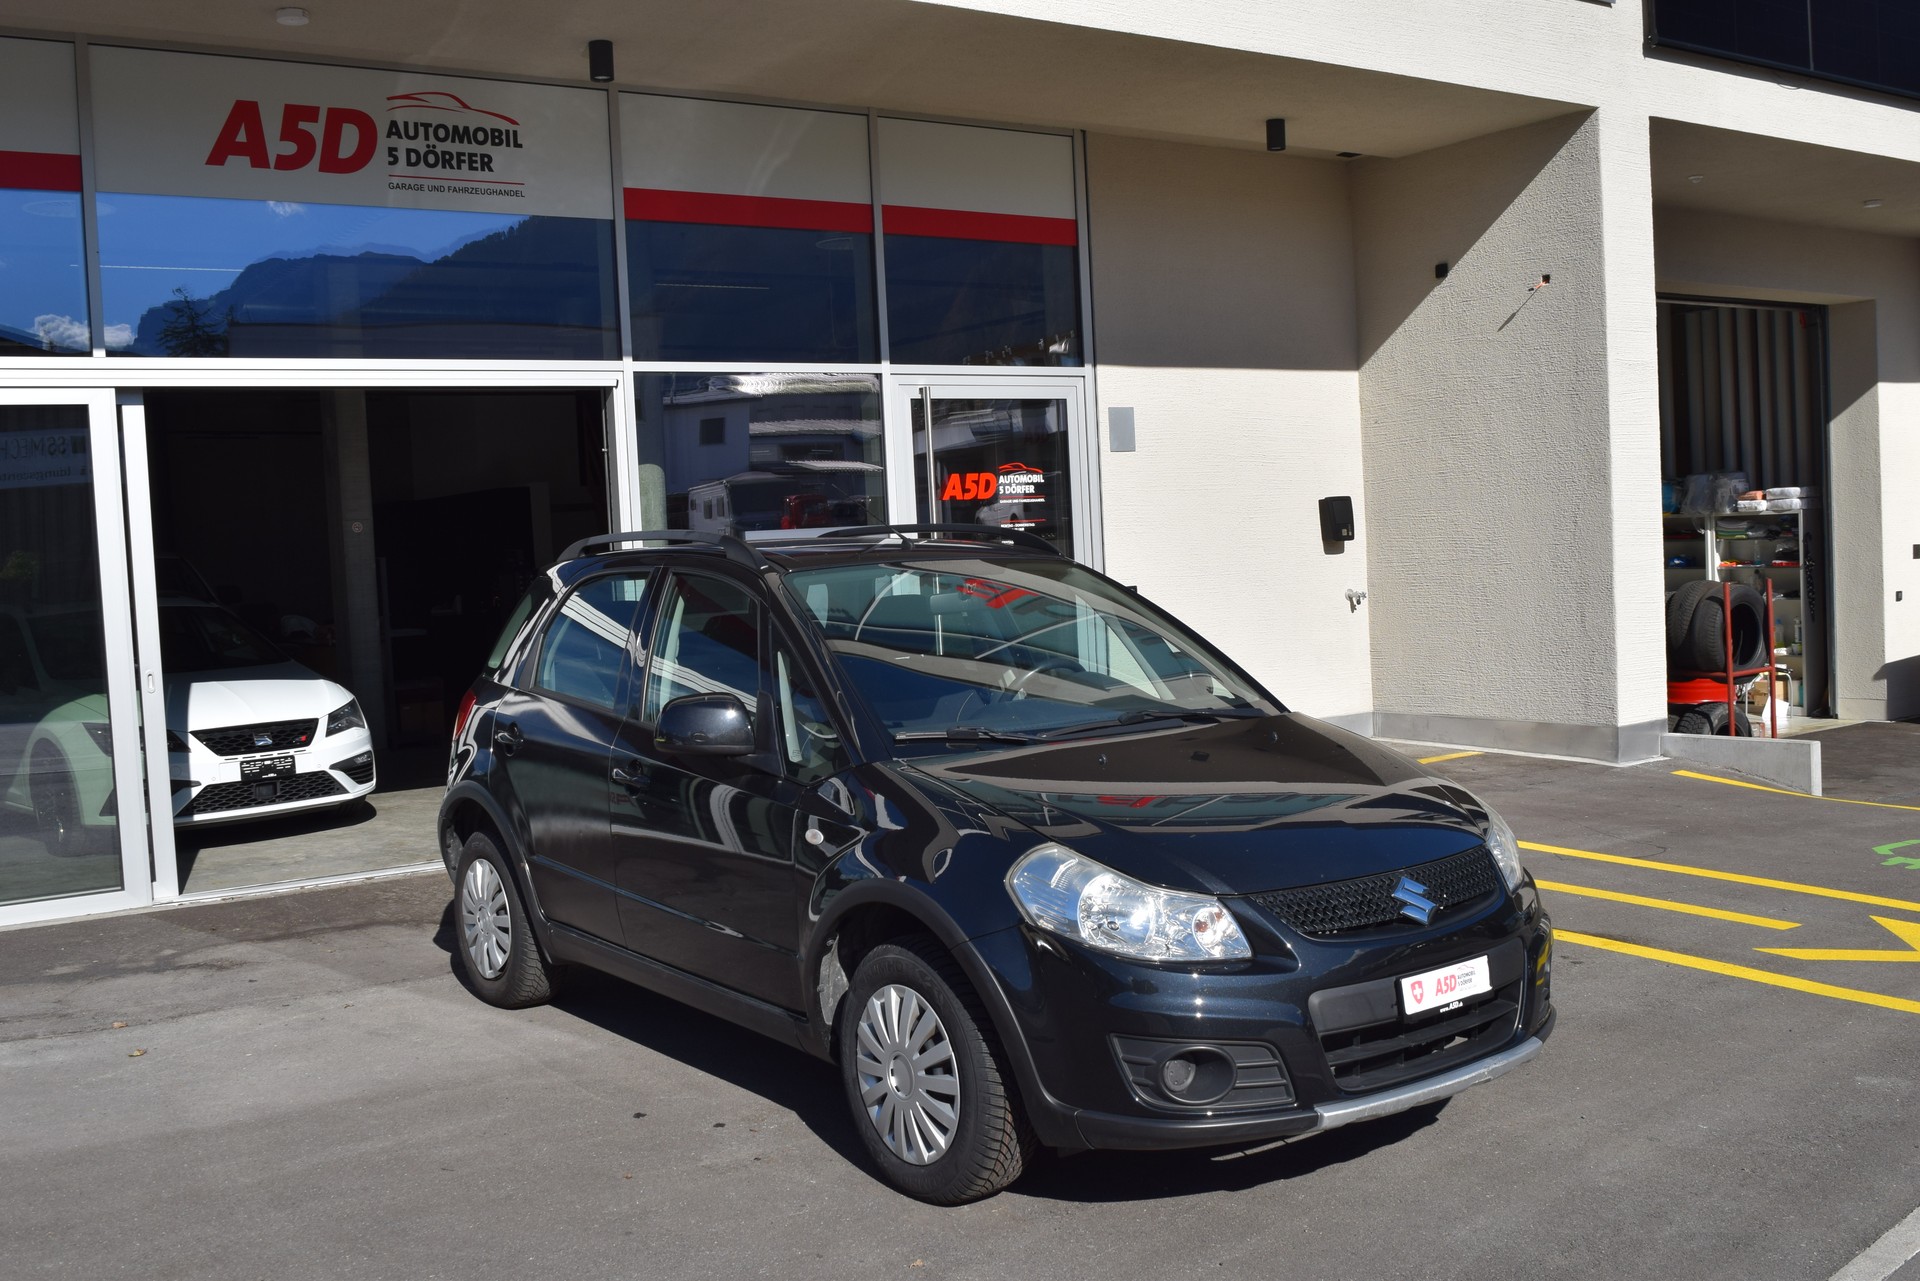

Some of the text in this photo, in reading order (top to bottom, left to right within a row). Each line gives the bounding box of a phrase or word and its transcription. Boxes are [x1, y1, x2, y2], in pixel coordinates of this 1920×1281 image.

[205, 99, 378, 174] A5D
[386, 120, 523, 149] AUTOMOBIL
[387, 144, 494, 172] 5 DÖRFER
[388, 182, 526, 198] GARAGE UND FAHRZEUGHANDEL
[942, 472, 997, 501] A5D
[999, 474, 1045, 484] AUTOMOBIL
[999, 484, 1035, 495] 5 DÖRFER
[1435, 974, 1457, 997] A5D
